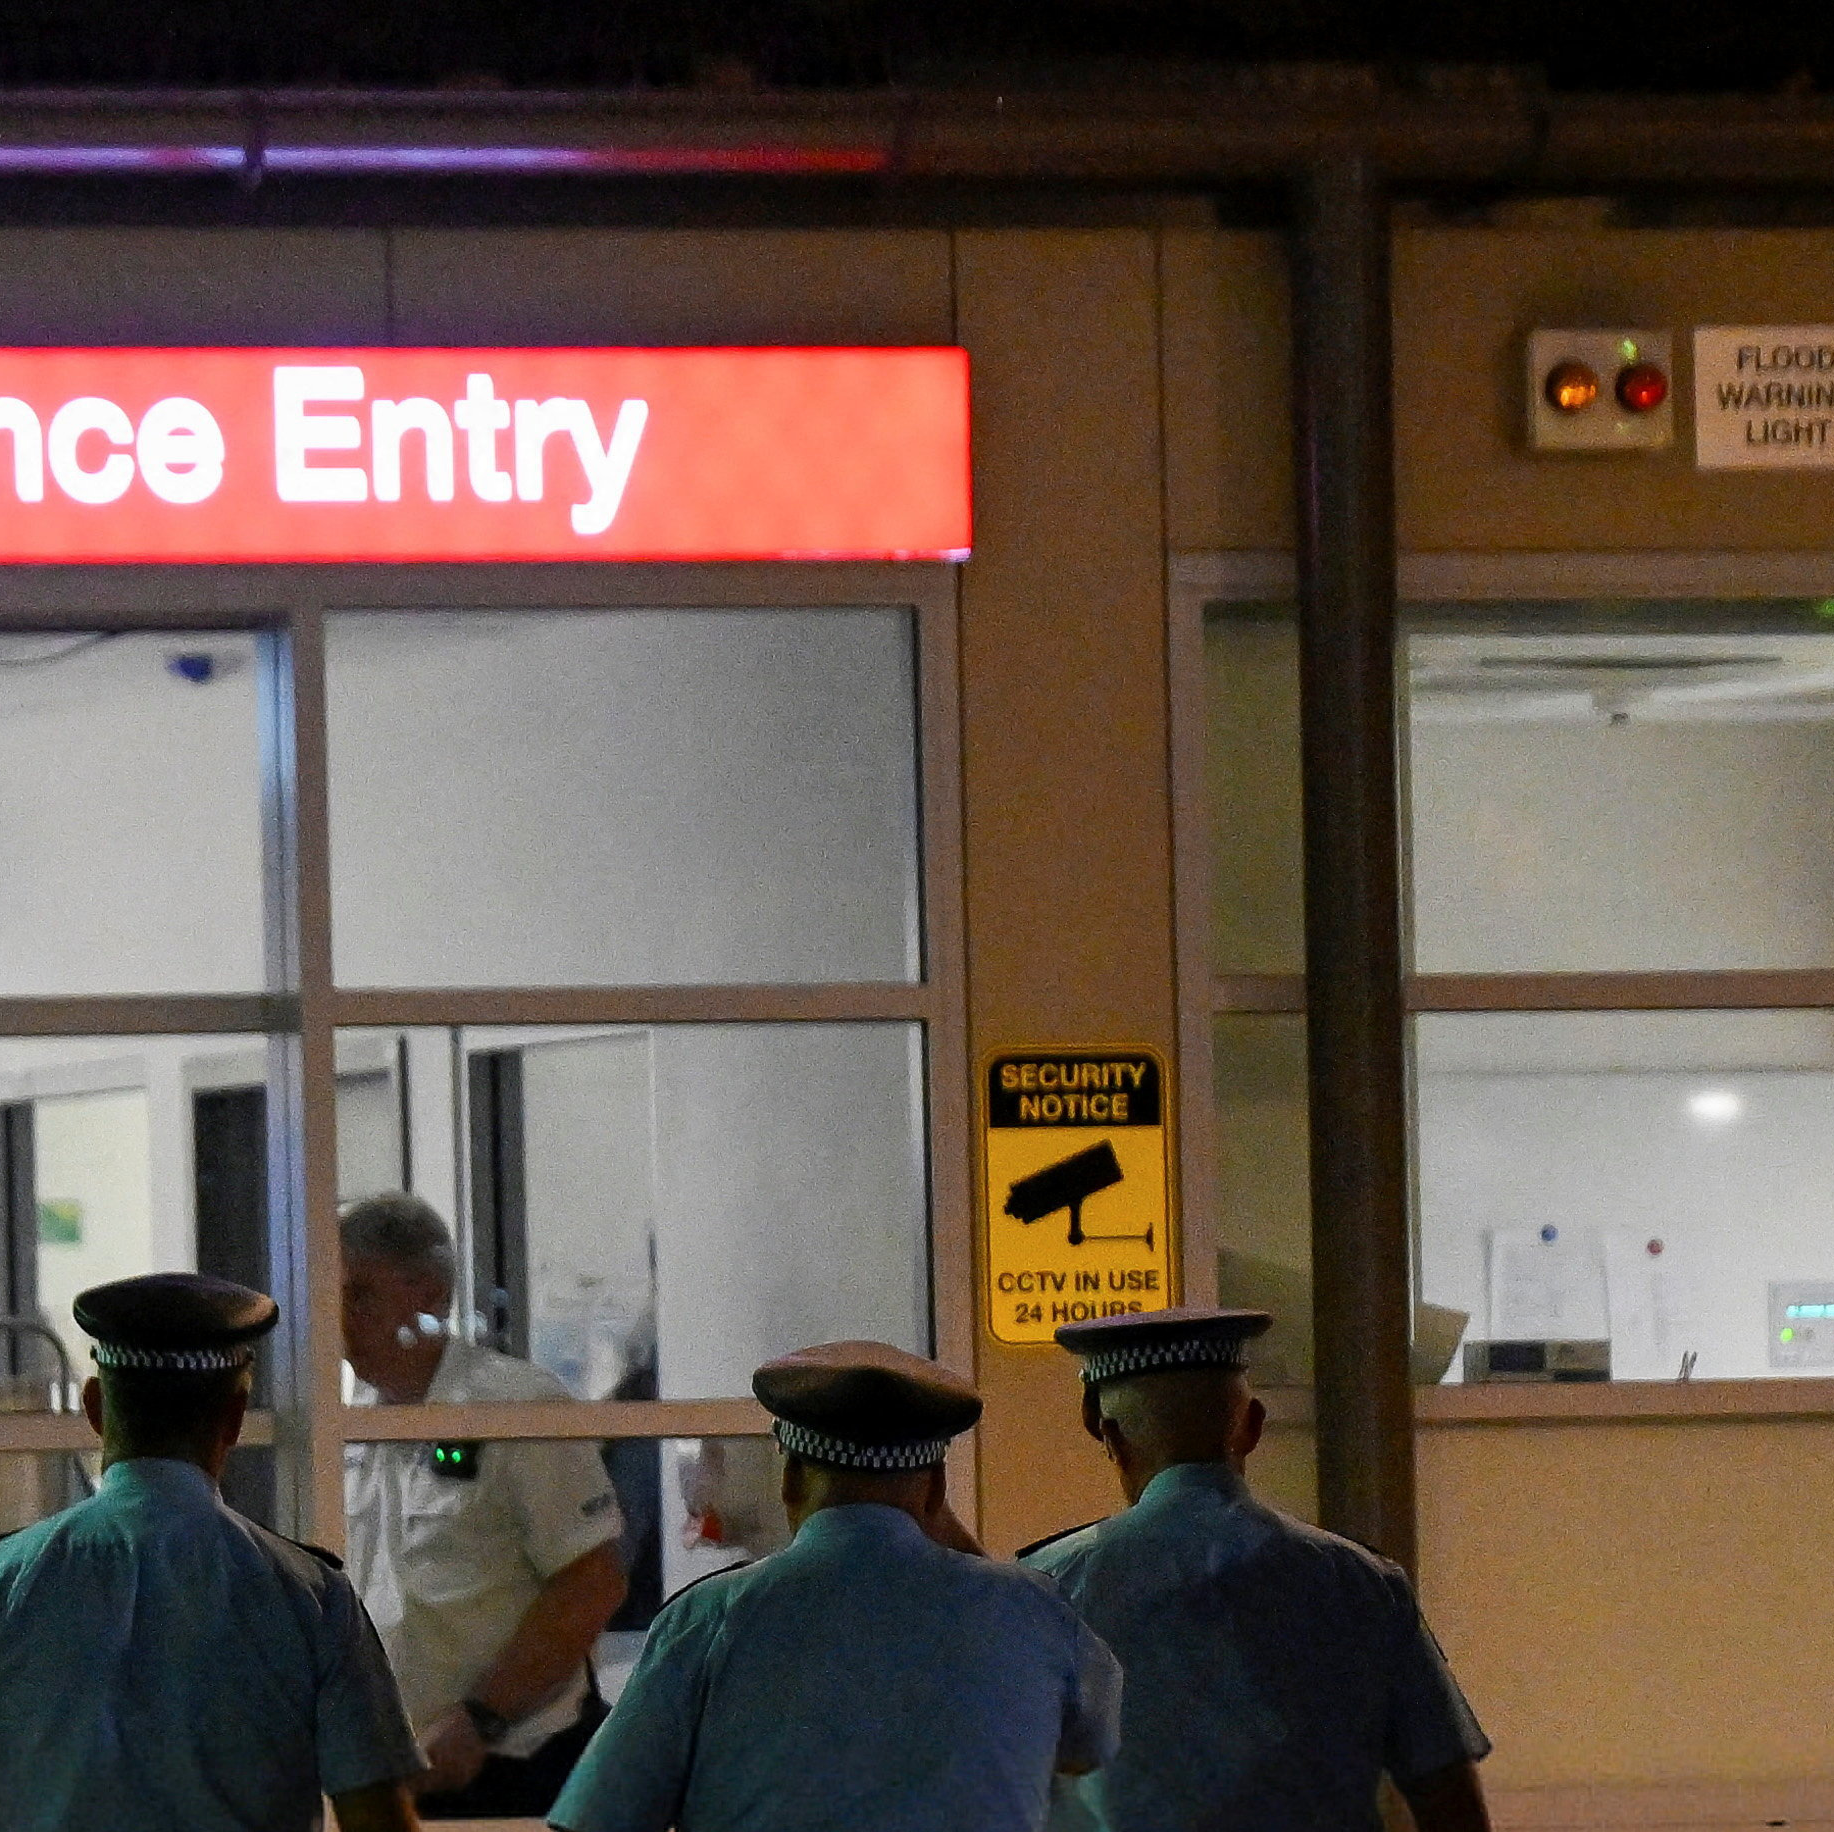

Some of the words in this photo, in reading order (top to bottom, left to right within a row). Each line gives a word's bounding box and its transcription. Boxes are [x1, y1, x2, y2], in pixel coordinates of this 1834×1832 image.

[1745, 417, 1832, 447] LIGHT
[273, 364, 648, 536] Entry
[1001, 1062, 1146, 1088] SECURITY
[1020, 1093, 1128, 1120] NOTICE
[997, 1270, 1066, 1292] CCTV
[1075, 1269, 1100, 1291] IN
[1109, 1269, 1160, 1291] USE
[1015, 1301, 1042, 1323] 24
